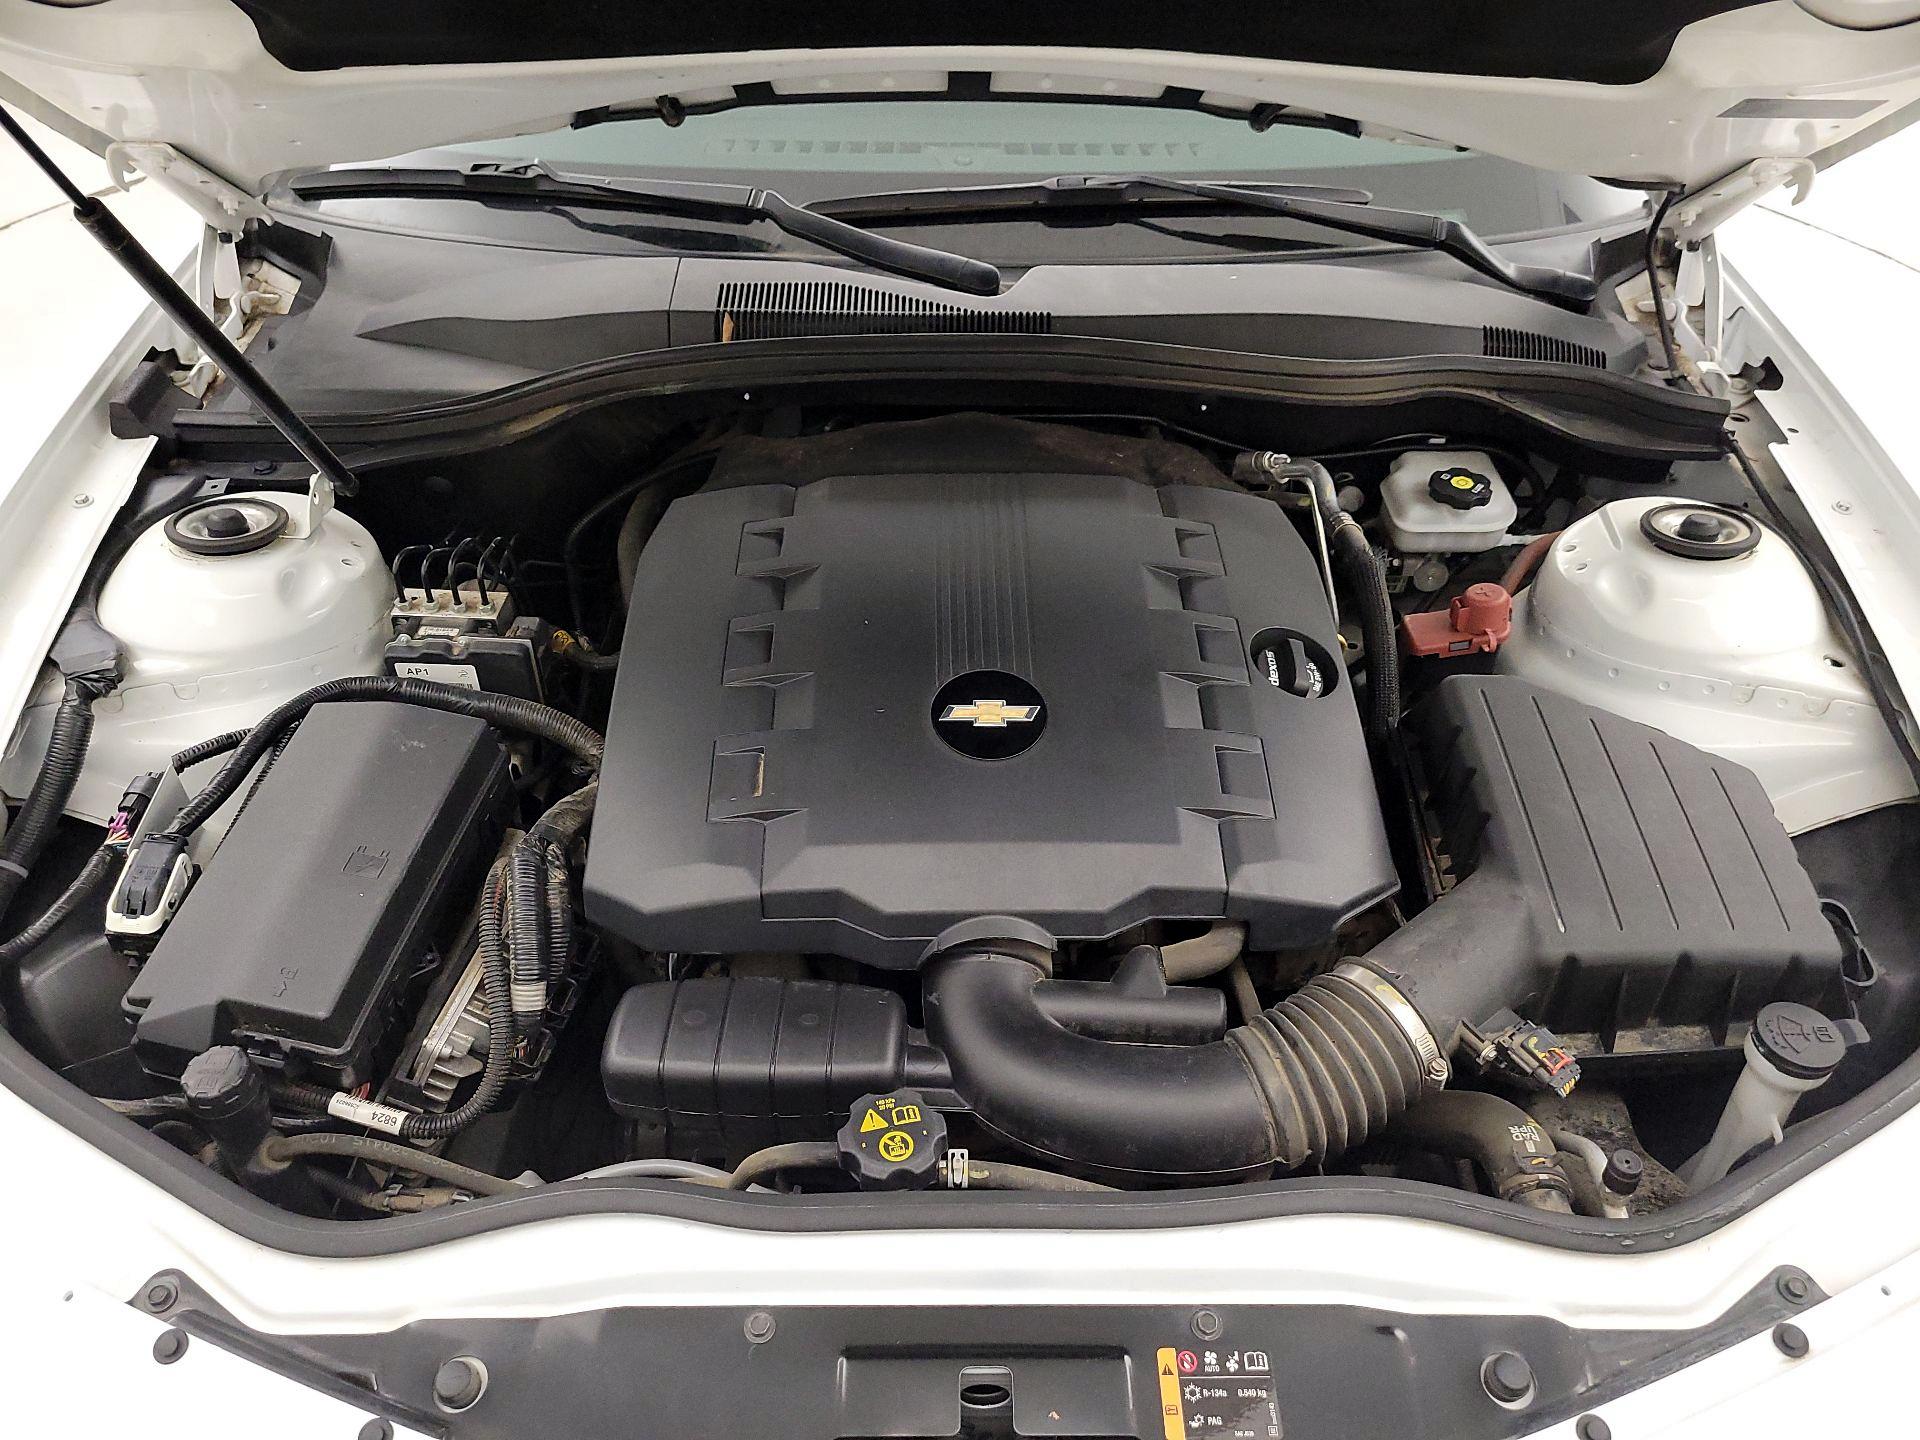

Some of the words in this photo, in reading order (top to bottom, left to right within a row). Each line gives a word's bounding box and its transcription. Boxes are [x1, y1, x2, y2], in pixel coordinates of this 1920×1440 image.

[406, 667, 429, 676] AP1
[1265, 649, 1280, 686] dexos
[371, 1110, 398, 1127] 6824
[1507, 1124, 1538, 1135] UPR
[1512, 1132, 1541, 1142] RAD
[1204, 1364, 1221, 1373] AUTO
[1202, 1388, 1228, 1398] R-134a
[1257, 1388, 1268, 1399] kg
[1207, 1416, 1223, 1426] PAG
